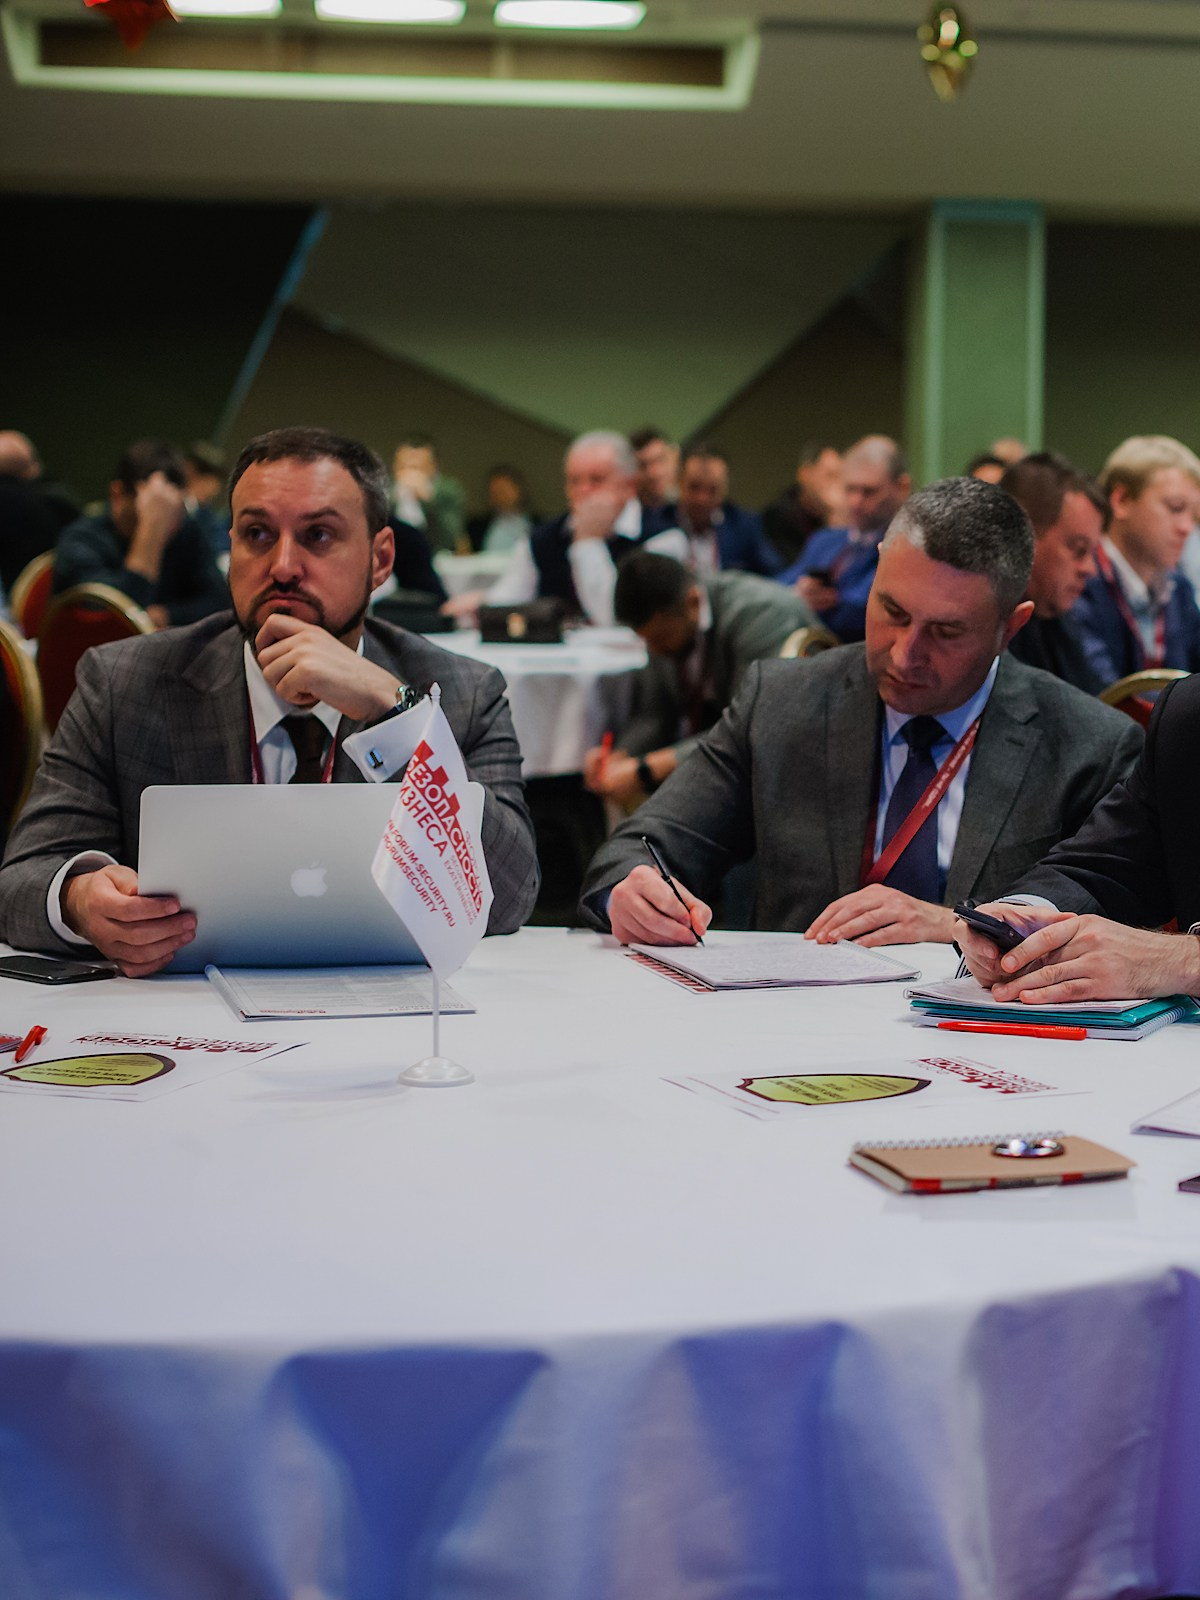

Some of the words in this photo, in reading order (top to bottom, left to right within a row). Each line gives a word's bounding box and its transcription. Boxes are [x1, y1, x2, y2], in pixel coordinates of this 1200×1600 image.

[400, 785, 448, 857] ИЗНЕСА
[406, 754, 483, 912] БЕЗОПАСНОСТЬ
[384, 834, 437, 913] FORUMSECURITY
